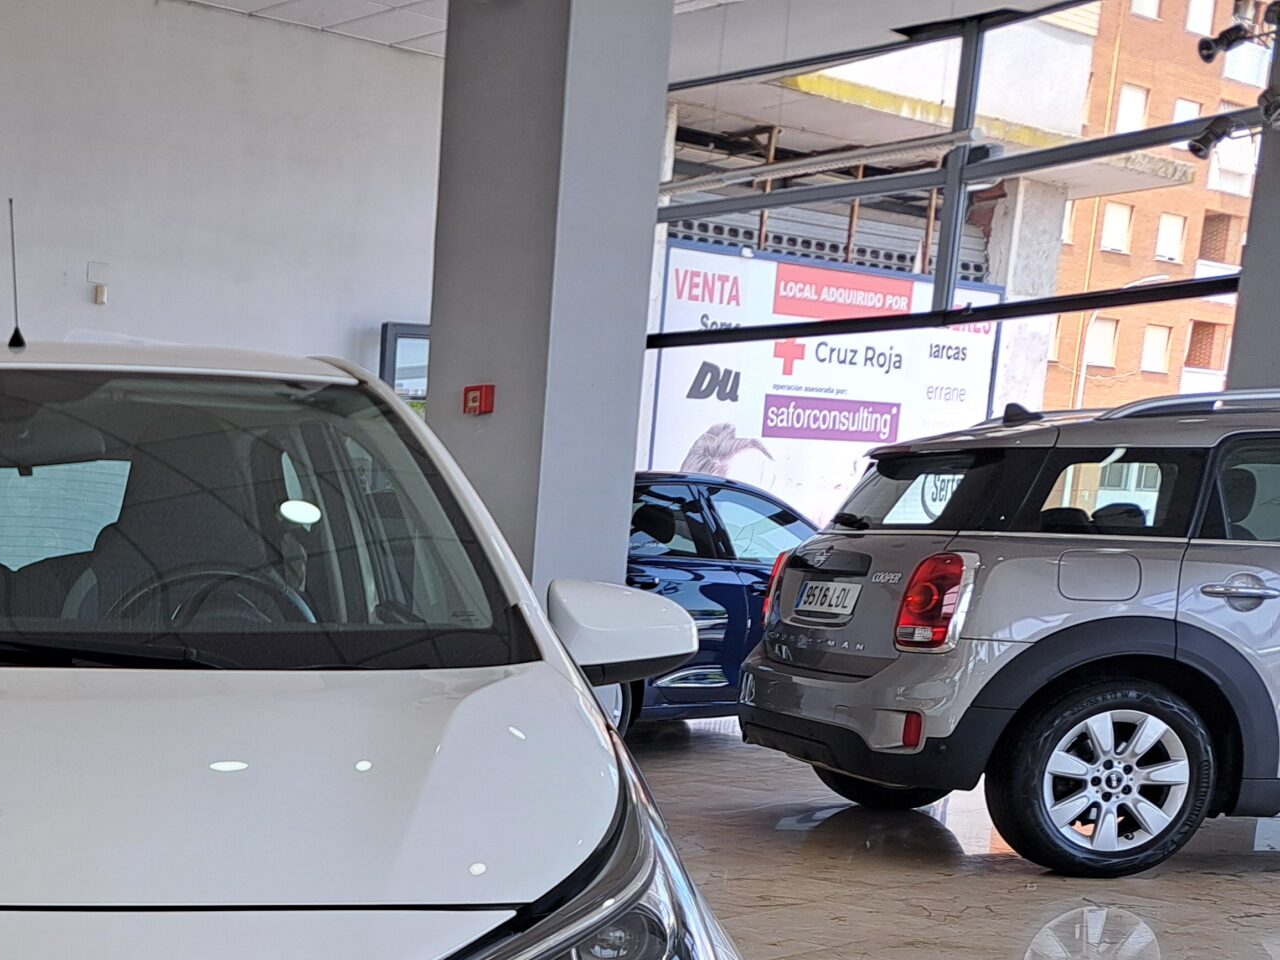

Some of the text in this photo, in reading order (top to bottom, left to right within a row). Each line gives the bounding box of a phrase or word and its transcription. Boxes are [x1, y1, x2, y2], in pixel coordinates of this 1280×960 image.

[674, 267, 741, 307] VENTA
[779, 280, 909, 311] LOCAL ADQUIRIDO POR
[815, 341, 903, 374] Cruz Roja
[766, 401, 893, 440] saforconsulting
[871, 571, 902, 583] COOPER
[803, 585, 851, 609] 9516 LDL
